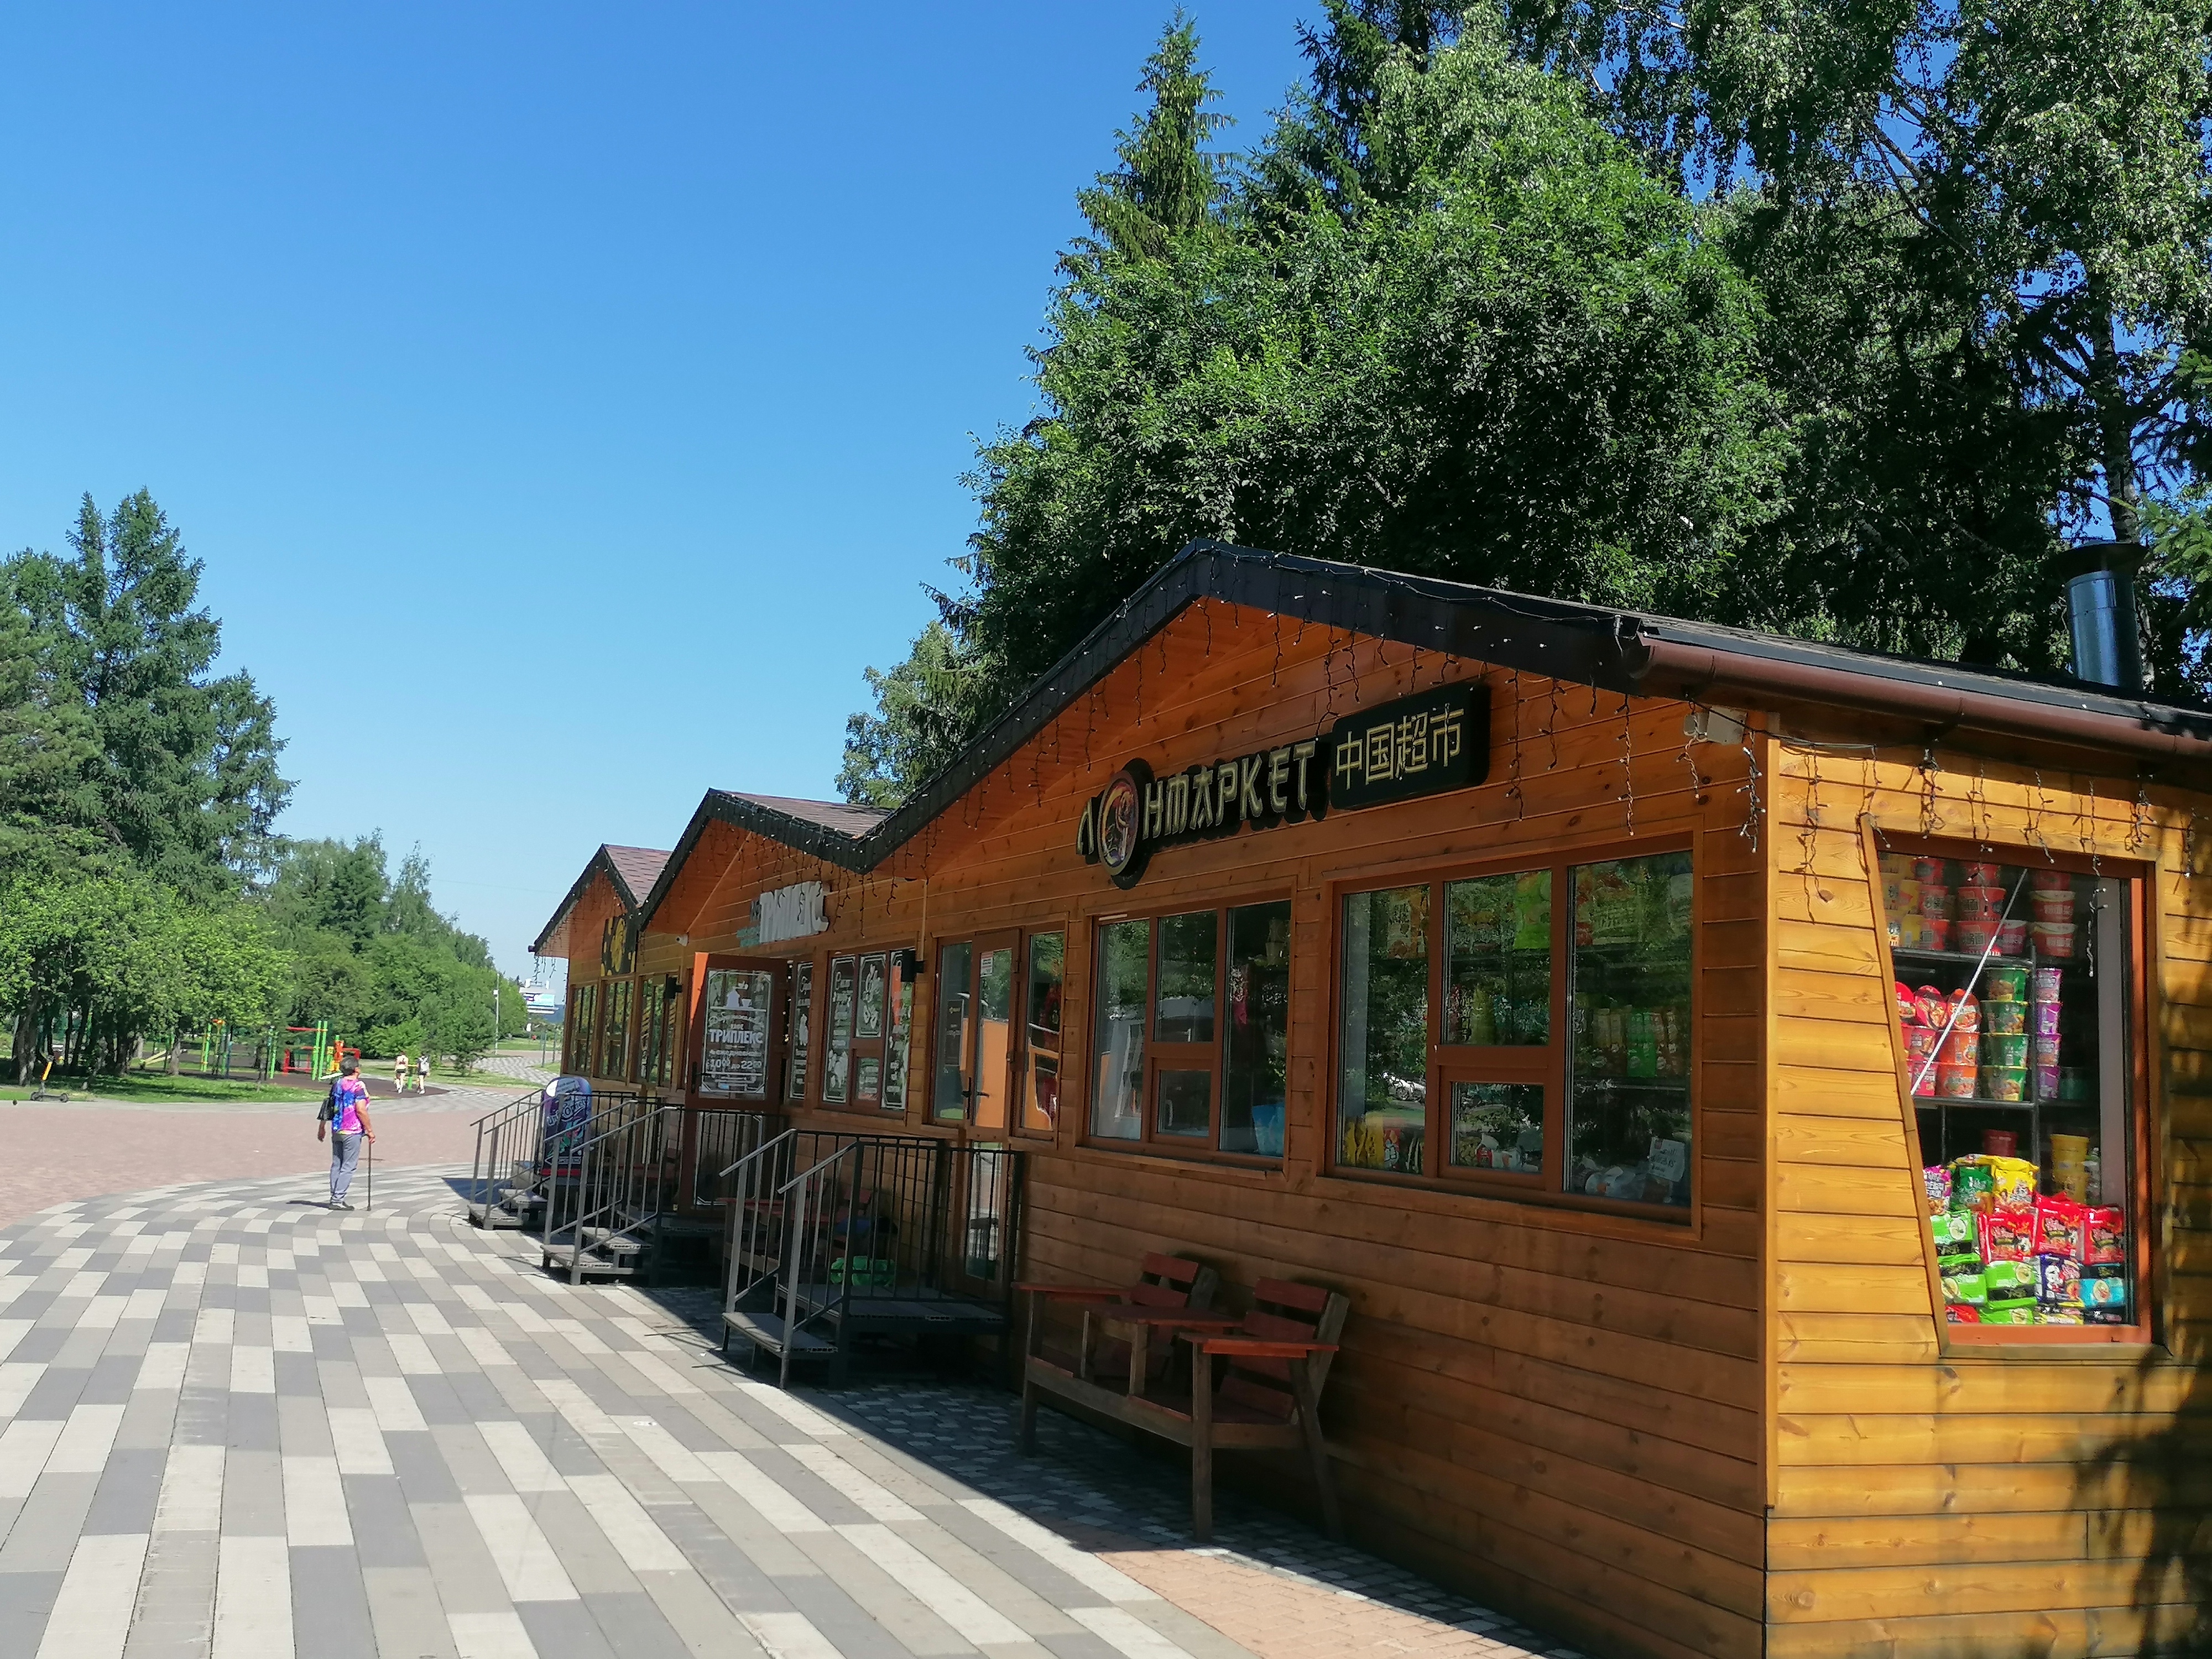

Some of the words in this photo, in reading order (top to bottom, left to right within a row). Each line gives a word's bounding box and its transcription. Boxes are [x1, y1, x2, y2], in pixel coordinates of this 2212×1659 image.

[1335, 702, 1465, 790] 中国超市
[709, 1029, 764, 1044] ТРИПЛЕКС
